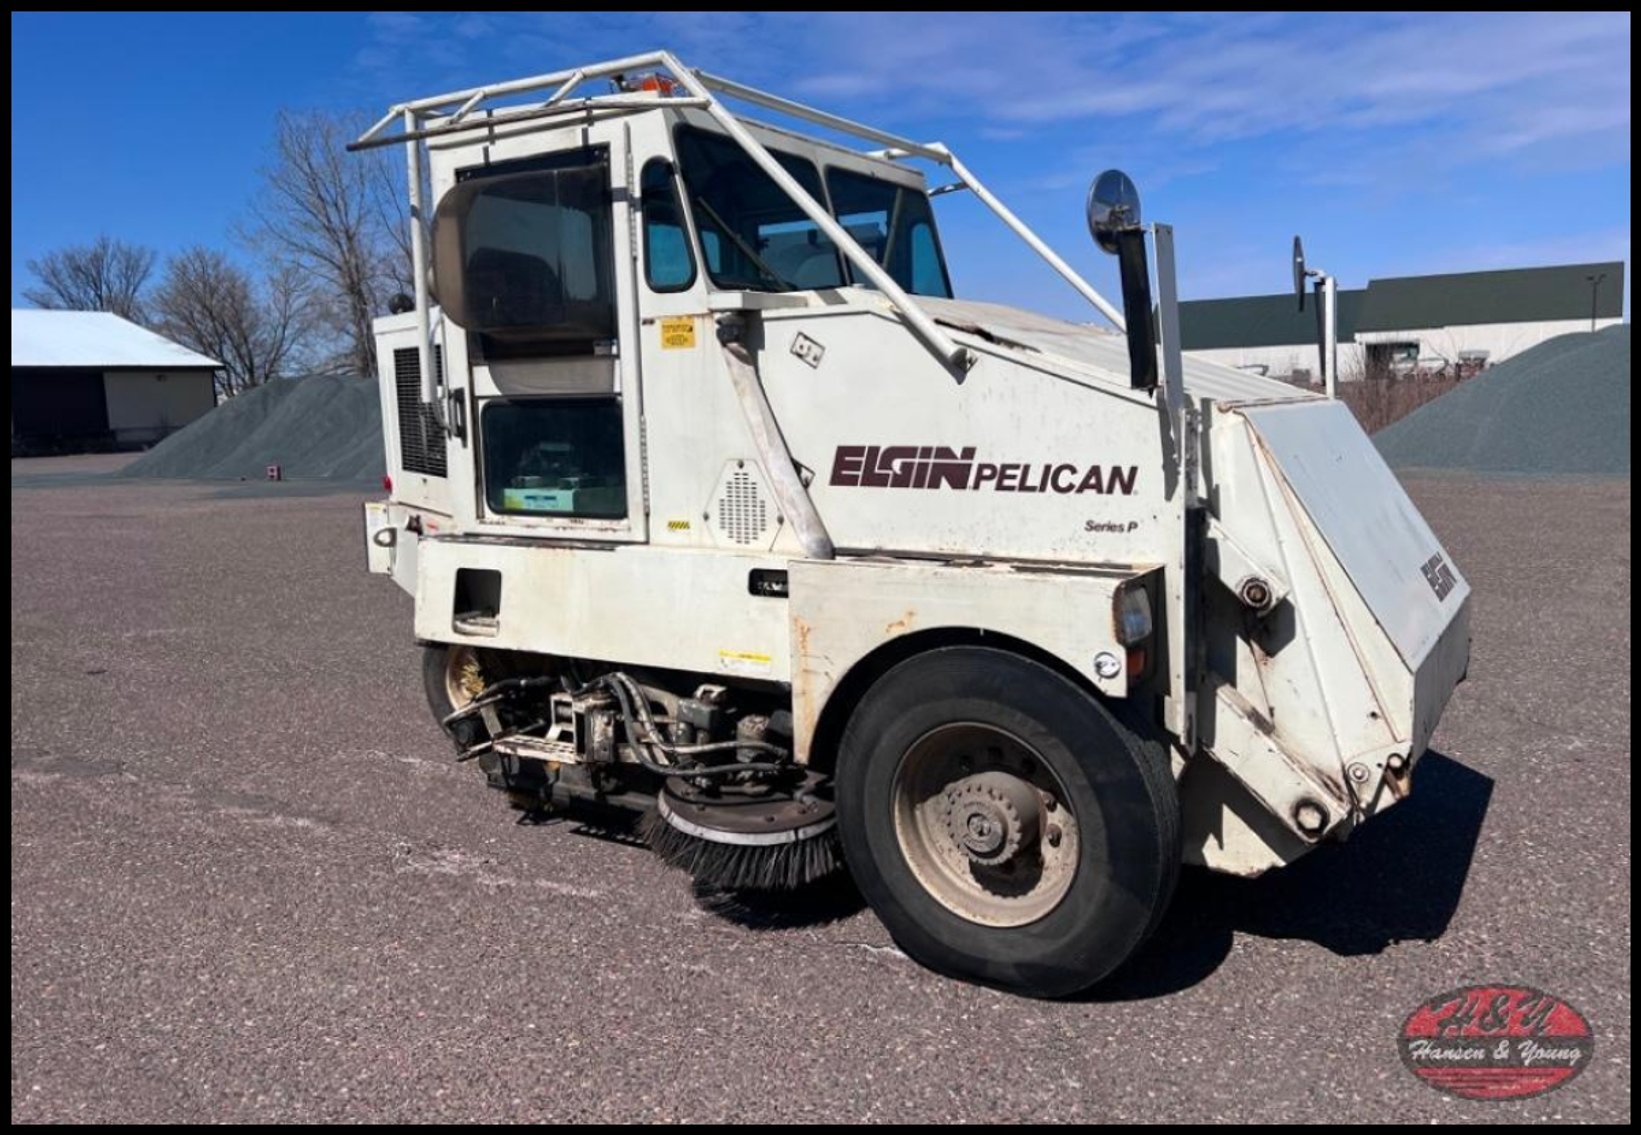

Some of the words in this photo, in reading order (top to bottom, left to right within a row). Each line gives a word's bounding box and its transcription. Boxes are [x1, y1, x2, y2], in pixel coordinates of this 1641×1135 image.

[829, 445, 977, 490] ELGIN
[972, 463, 1138, 495] PELICAN
[1084, 519, 1125, 533] Series
[1126, 520, 1139, 533] P
